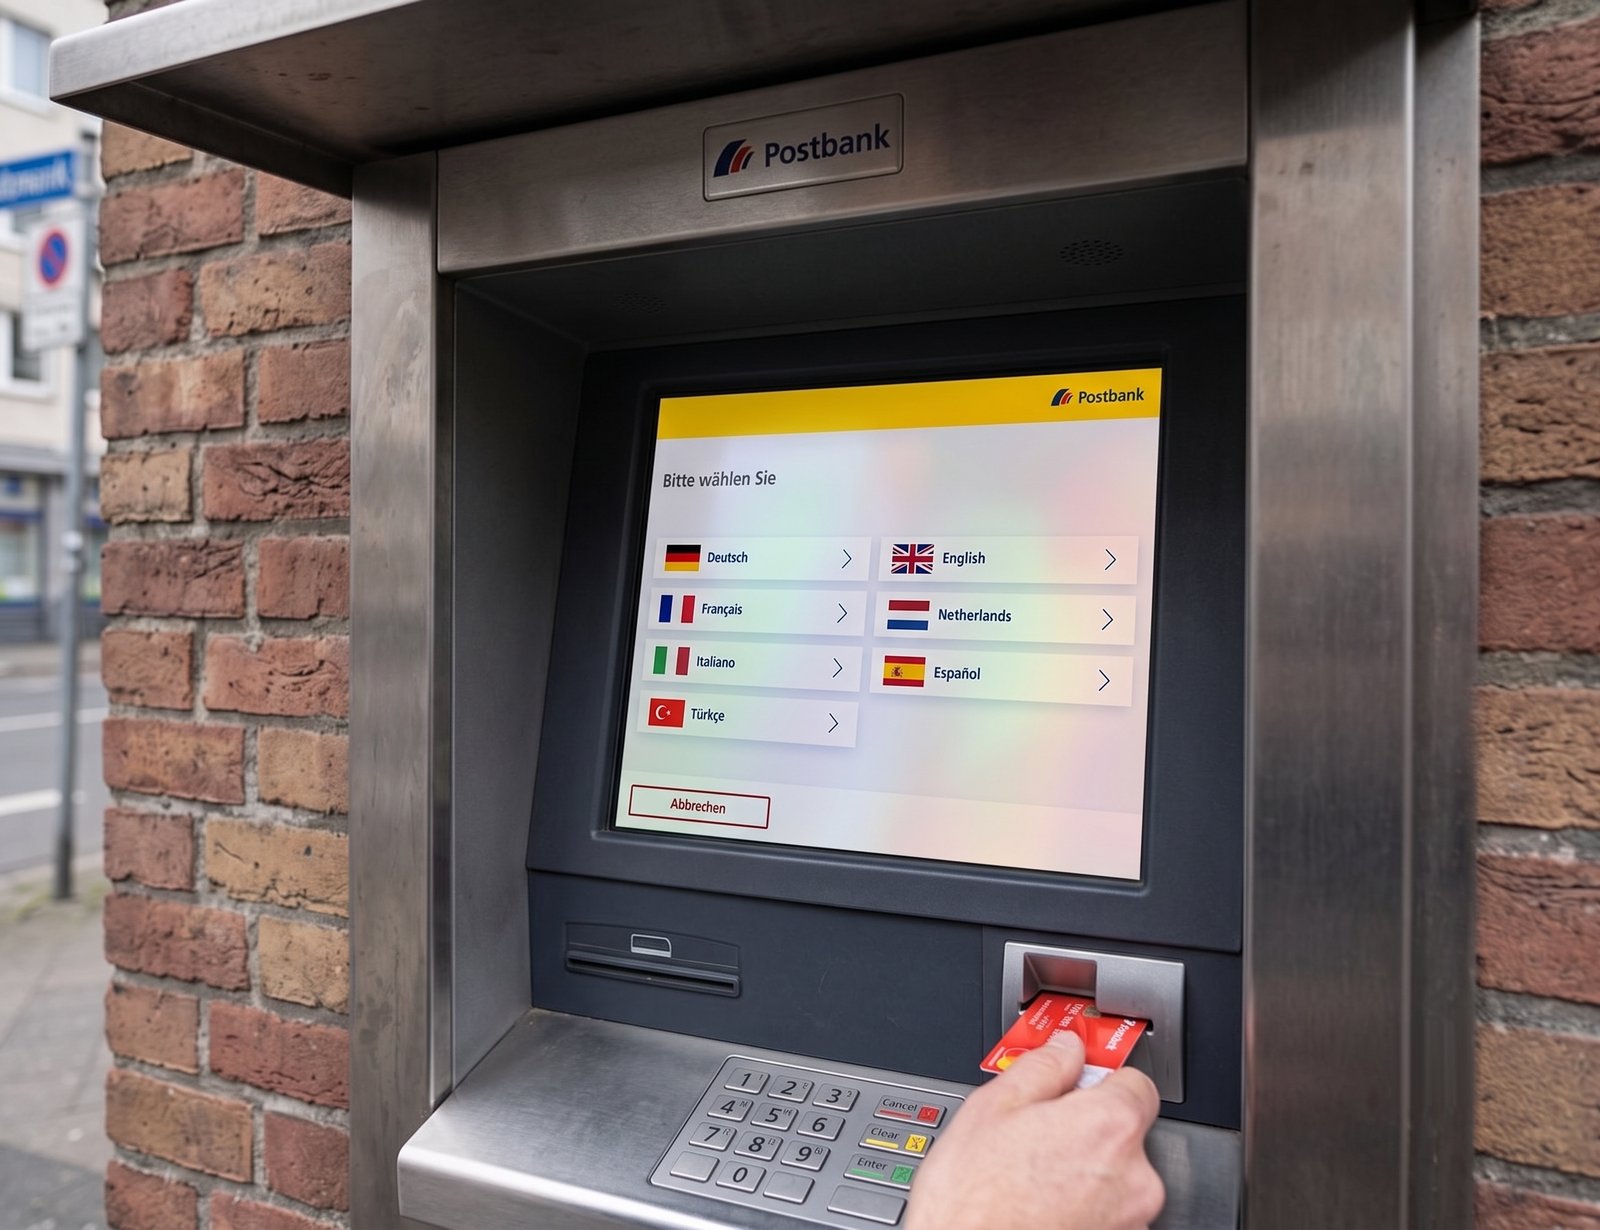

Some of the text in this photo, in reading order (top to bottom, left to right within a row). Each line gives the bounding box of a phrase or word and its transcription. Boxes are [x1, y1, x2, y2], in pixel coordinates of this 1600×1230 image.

[765, 123, 890, 167] Postbank
[1078, 387, 1145, 404] Postbank
[663, 470, 777, 488] Bitte wählen Sie
[707, 551, 748, 564] Deutsch
[942, 552, 986, 567] English
[701, 603, 743, 618] Français
[938, 609, 1012, 622] Netherlands
[696, 656, 736, 669] Italiano
[934, 666, 981, 682] Español
[691, 708, 725, 724] Türkçe
[670, 798, 726, 814] Abbrechen
[741, 1073, 752, 1087] 1
[780, 1081, 797, 1096] 2
[826, 1088, 842, 1103] 3
[720, 1100, 736, 1114] 4
[882, 1098, 918, 1112] Cancel
[764, 1108, 782, 1123] 5
[812, 1117, 828, 1133] 6
[704, 1126, 721, 1141] 7
[870, 1127, 900, 1140] Clear
[748, 1136, 765, 1152] 8
[795, 1146, 812, 1162] 9
[857, 1157, 888, 1171] Enter
[732, 1167, 748, 1183] 0
